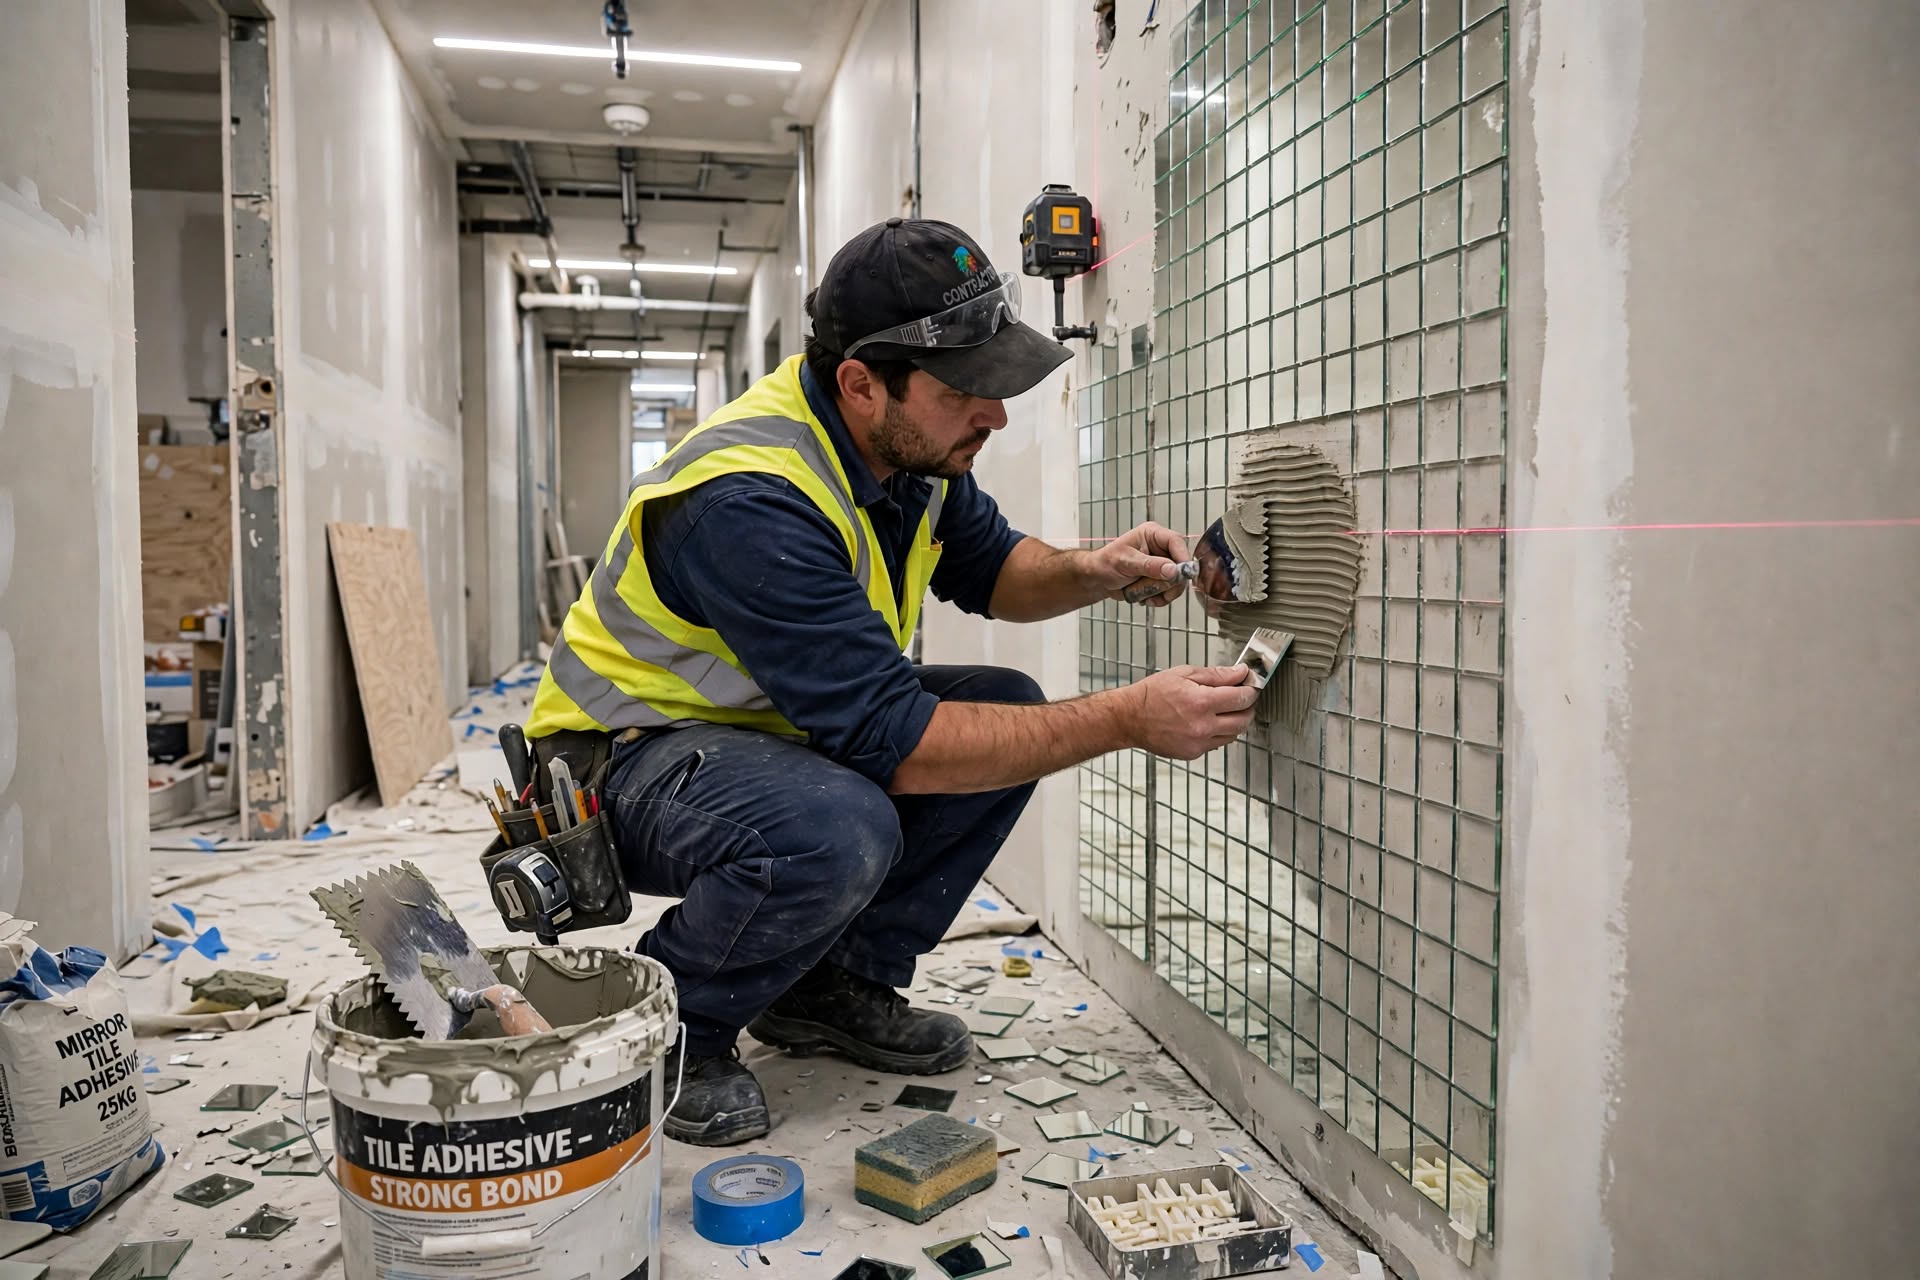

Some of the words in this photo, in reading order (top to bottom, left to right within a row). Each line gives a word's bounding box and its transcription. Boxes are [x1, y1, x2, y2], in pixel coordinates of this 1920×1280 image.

[55, 1013, 127, 1059] MIRROR
[82, 1039, 122, 1070] TILE
[97, 1085, 136, 1122] 25KG
[364, 1136, 414, 1172] TILE
[421, 1128, 572, 1174] ADHESIVE
[370, 1176, 472, 1208] STRONG
[481, 1171, 563, 1207] BOND
